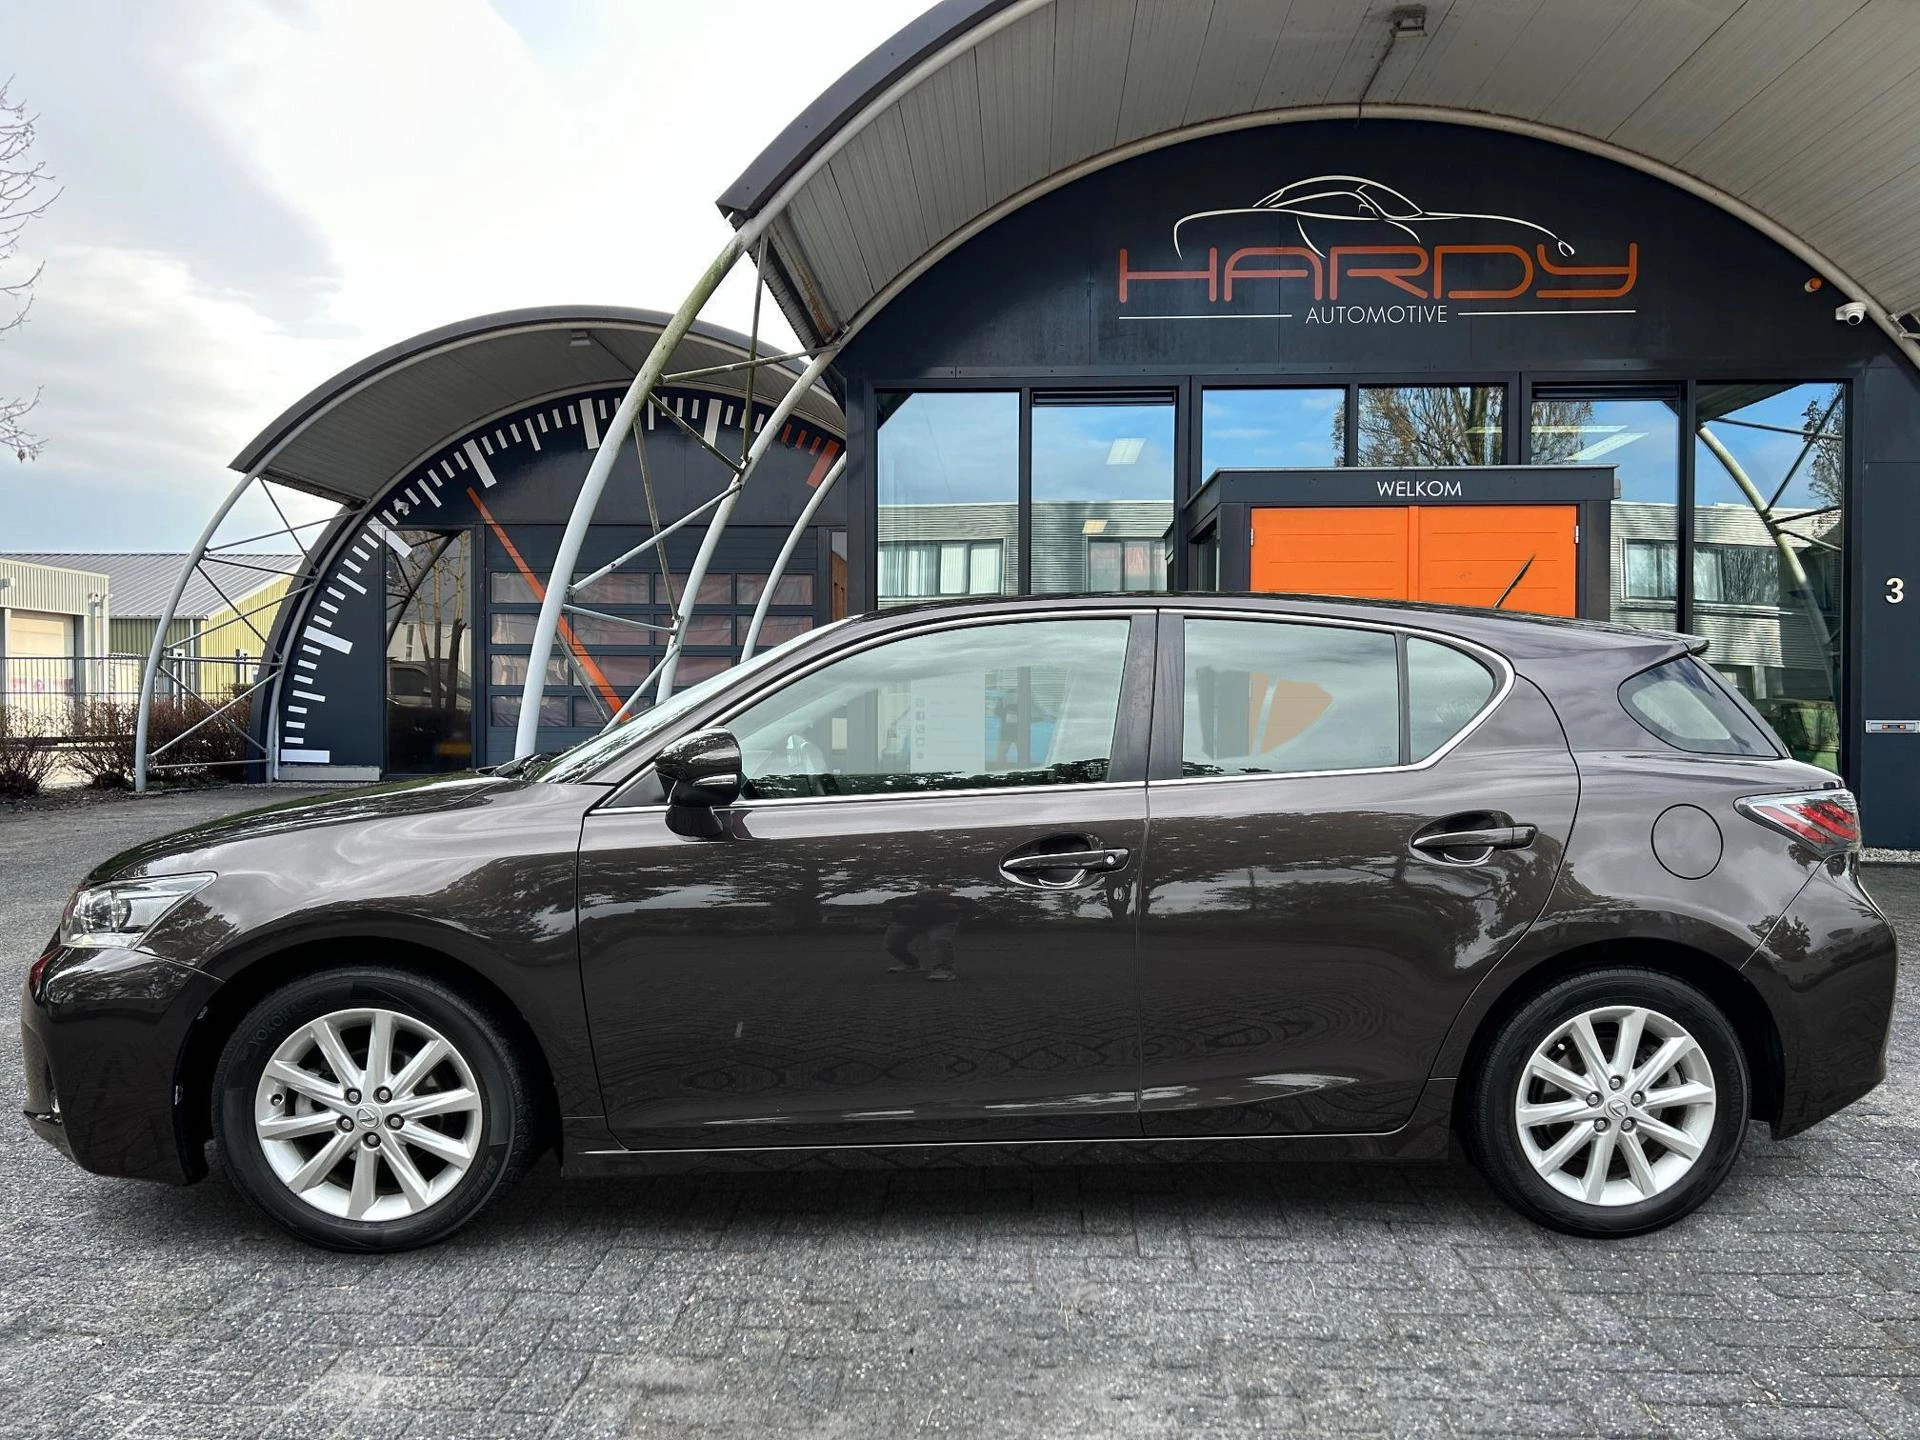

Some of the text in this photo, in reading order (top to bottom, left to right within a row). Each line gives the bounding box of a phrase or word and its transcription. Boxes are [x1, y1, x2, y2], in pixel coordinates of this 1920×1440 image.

[1119, 243, 1638, 302] HARDY
[1305, 305, 1448, 324] AUTOMOTIVE
[1376, 480, 1462, 497] WELKOM
[1885, 577, 1904, 604] 3
